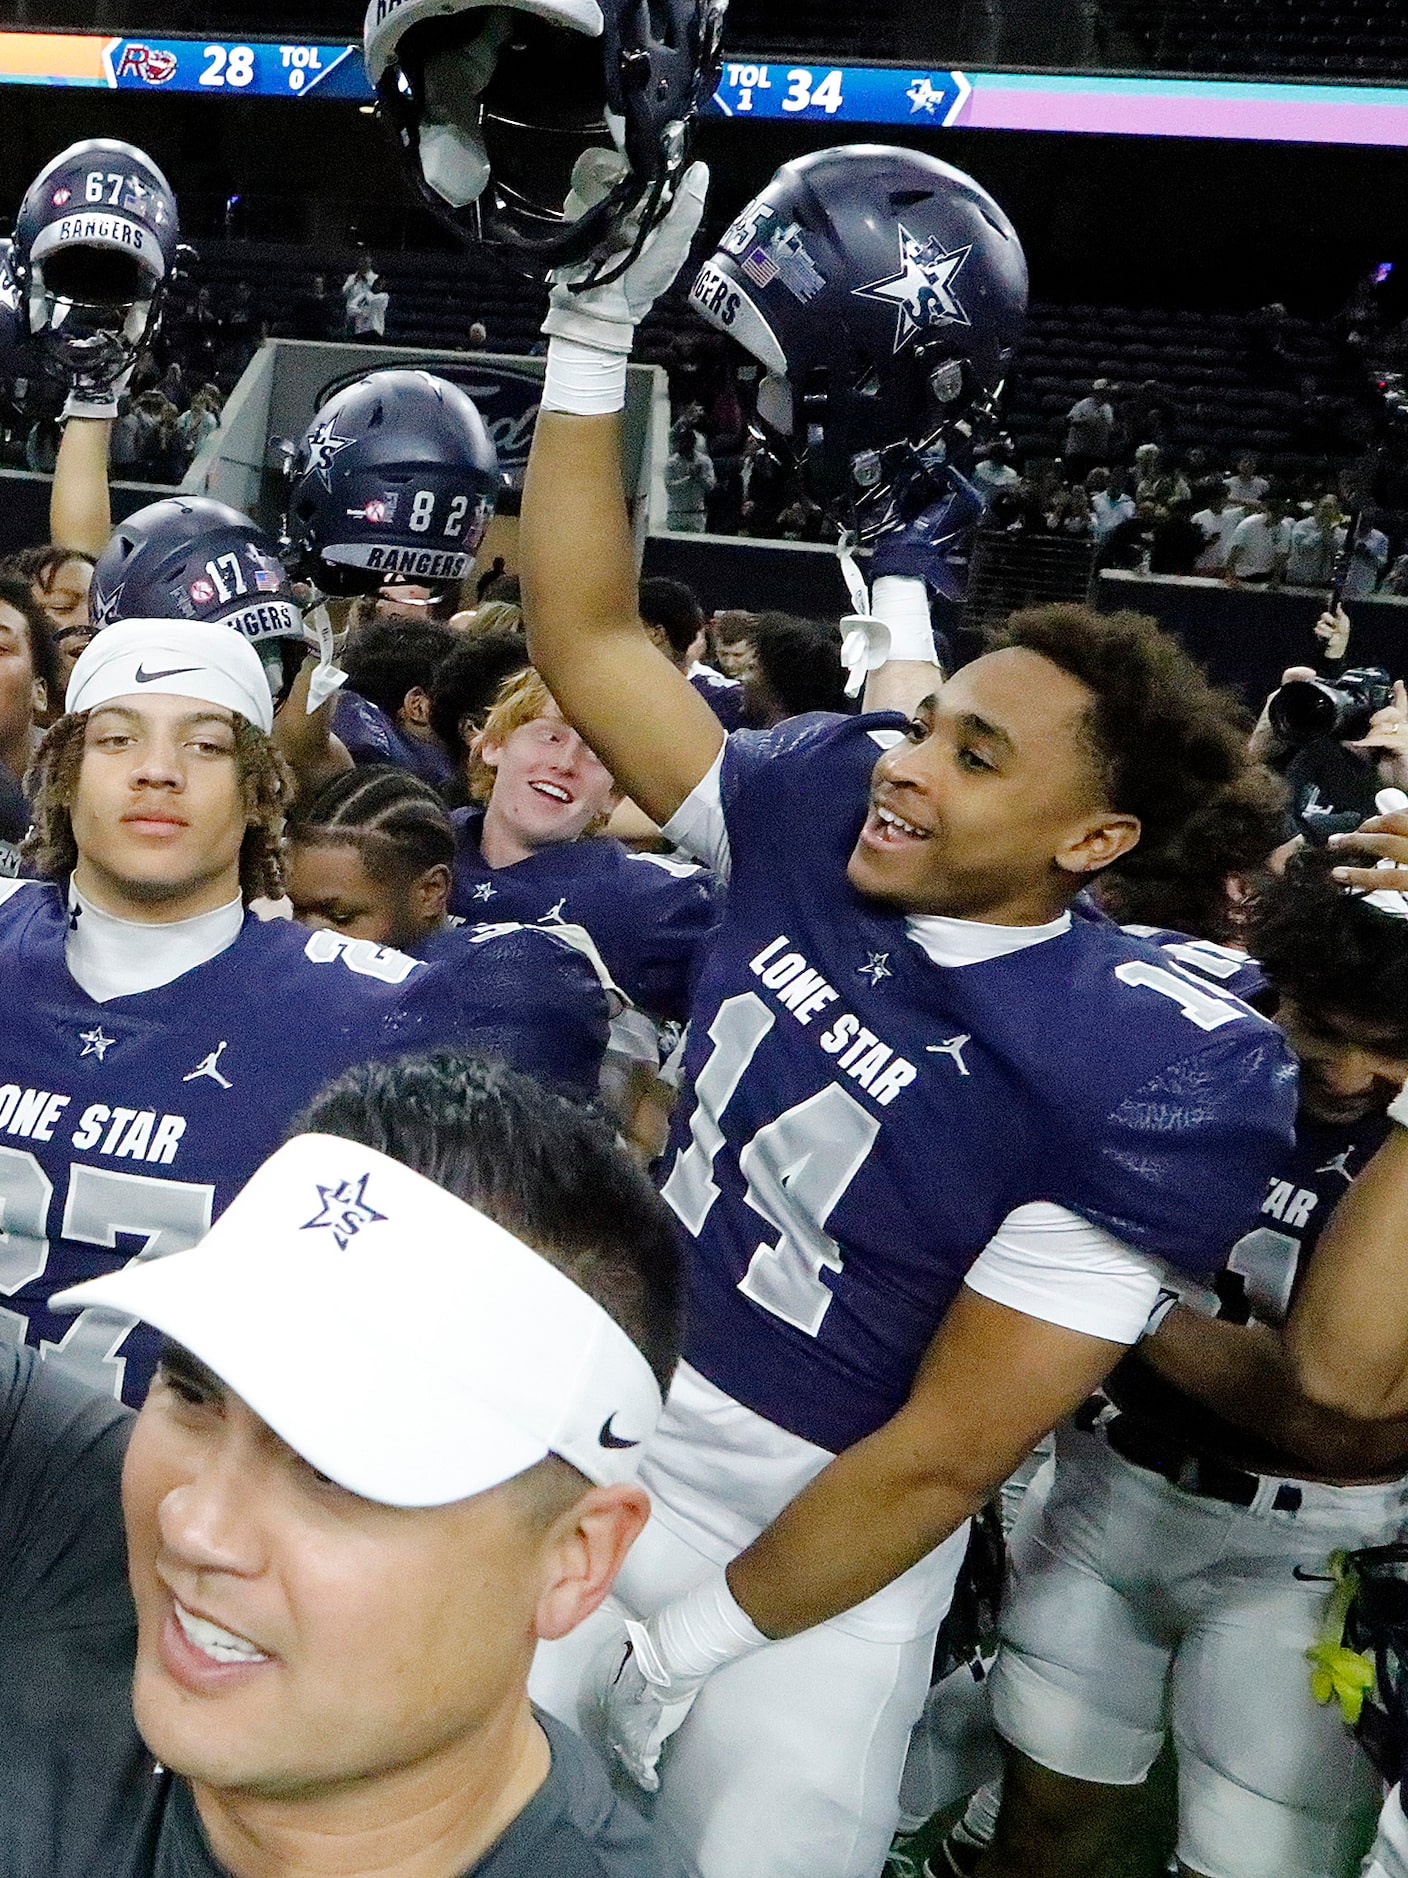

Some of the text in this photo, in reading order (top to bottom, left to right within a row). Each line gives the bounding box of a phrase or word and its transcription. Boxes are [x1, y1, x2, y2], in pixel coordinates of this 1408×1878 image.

[199, 46, 254, 87] 28
[280, 46, 322, 69] TOL
[727, 64, 771, 88] TOL
[288, 69, 305, 90] 0
[737, 89, 753, 111] 1
[782, 69, 843, 113] 34
[85, 171, 124, 205] 67
[60, 219, 144, 249] RANGERS
[693, 270, 741, 326] GERS
[408, 490, 469, 537] 82
[204, 551, 248, 604] 17
[365, 547, 466, 578] RANGERS
[748, 935, 918, 1106] LONE STAR
[71, 1103, 187, 1165] STAR
[660, 992, 882, 1338] 14
[1260, 1176, 1319, 1229] AR
